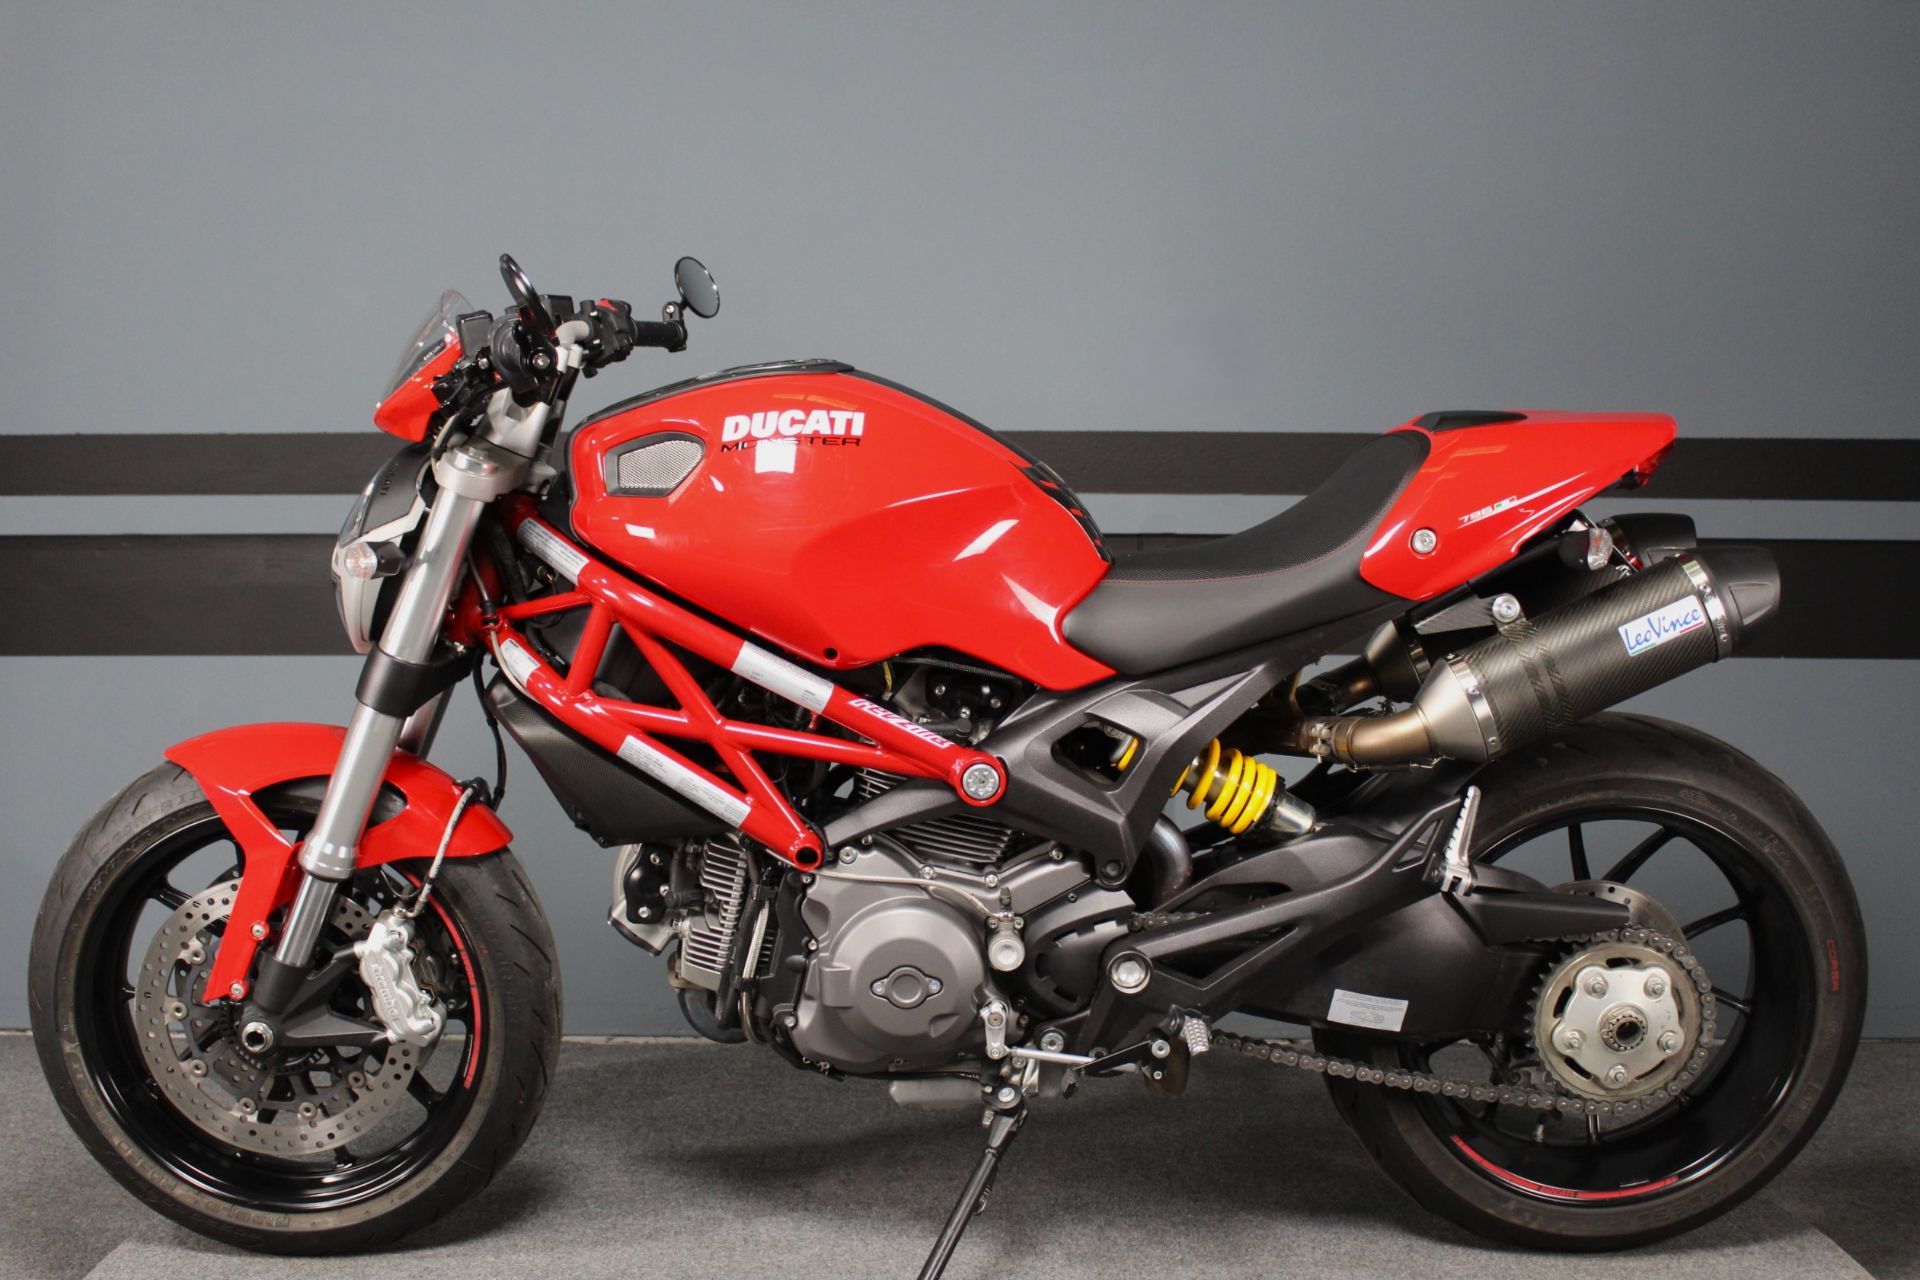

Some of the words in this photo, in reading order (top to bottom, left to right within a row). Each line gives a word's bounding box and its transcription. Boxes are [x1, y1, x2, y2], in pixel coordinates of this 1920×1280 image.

[721, 409, 865, 442] DUCATI
[721, 436, 861, 452] MOSTER
[1624, 608, 1700, 651] LeoVince
